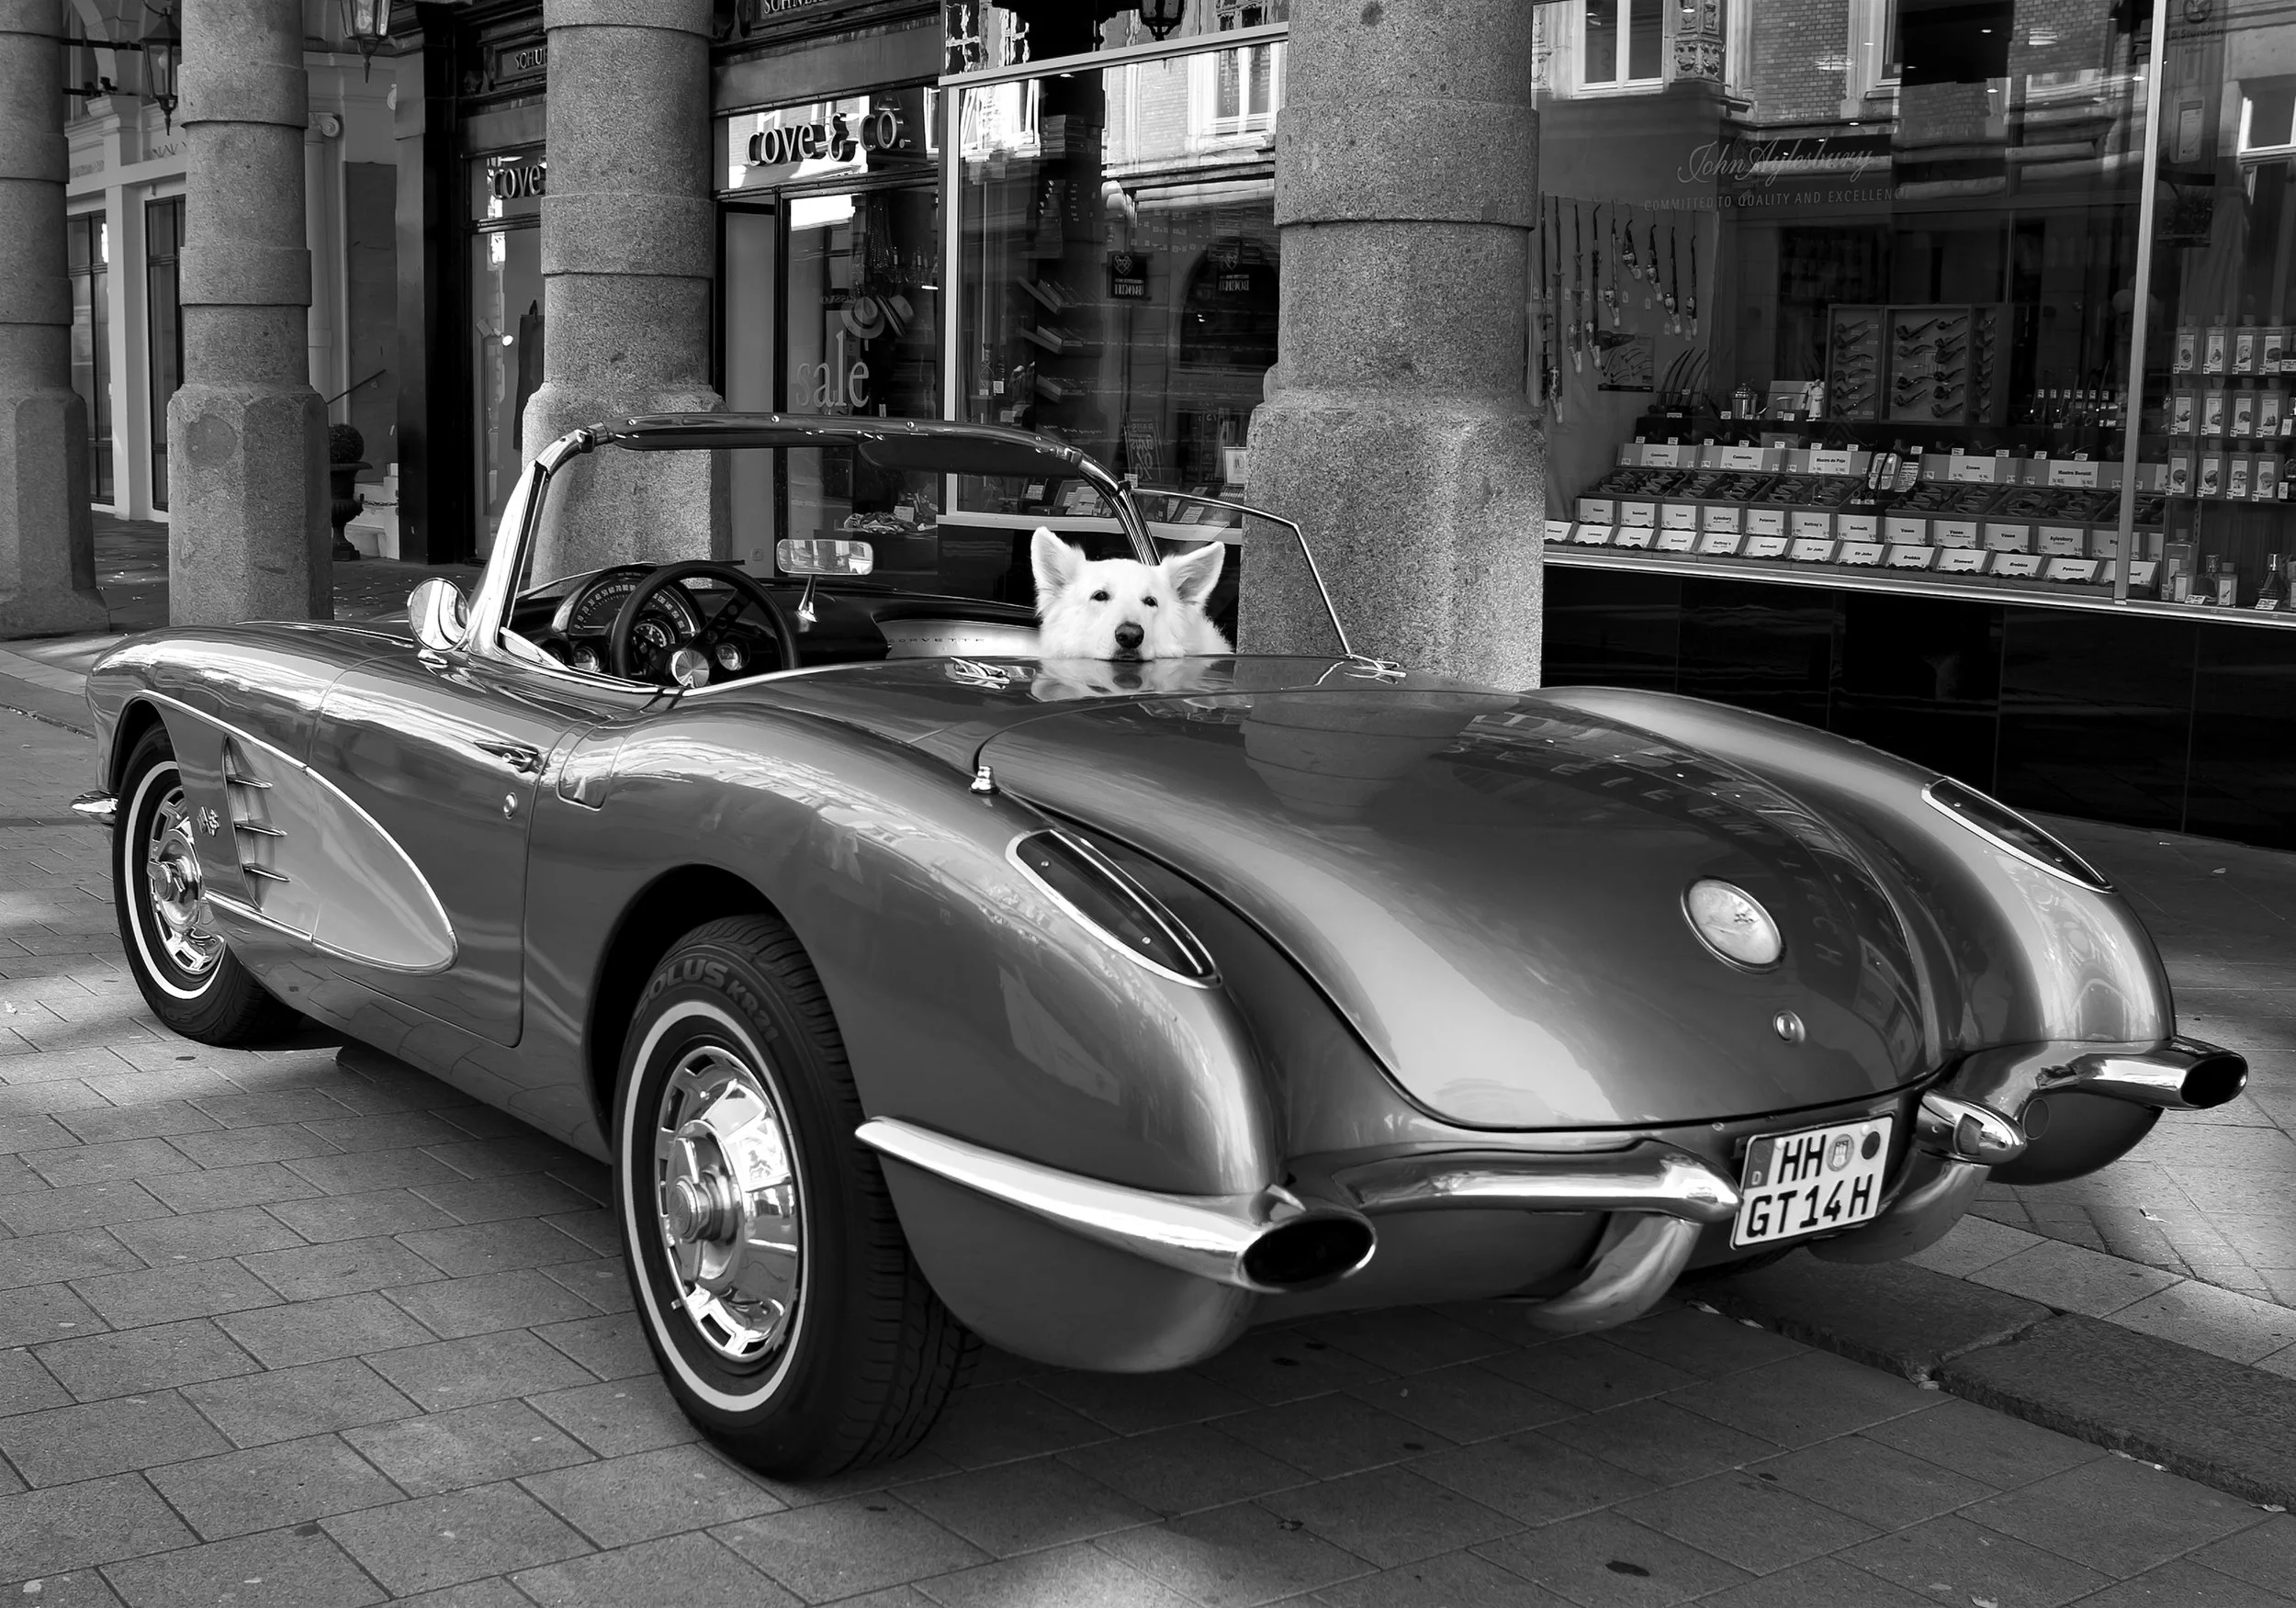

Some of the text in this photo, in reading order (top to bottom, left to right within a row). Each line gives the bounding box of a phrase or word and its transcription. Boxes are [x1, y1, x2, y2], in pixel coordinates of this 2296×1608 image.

[2180, 28, 2223, 39] Stunden
[747, 111, 909, 166] cove & co.
[1677, 136, 1874, 186] John Aylesbury
[491, 166, 542, 199] cove
[1644, 197, 1713, 211] COMMITTED
[1717, 196, 1732, 208] TO
[1738, 192, 1790, 208] QUALITY
[1795, 190, 1822, 204] AND
[795, 331, 870, 408] sale
[1751, 1171, 1761, 1186] D
[1777, 1134, 1827, 1184] HH
